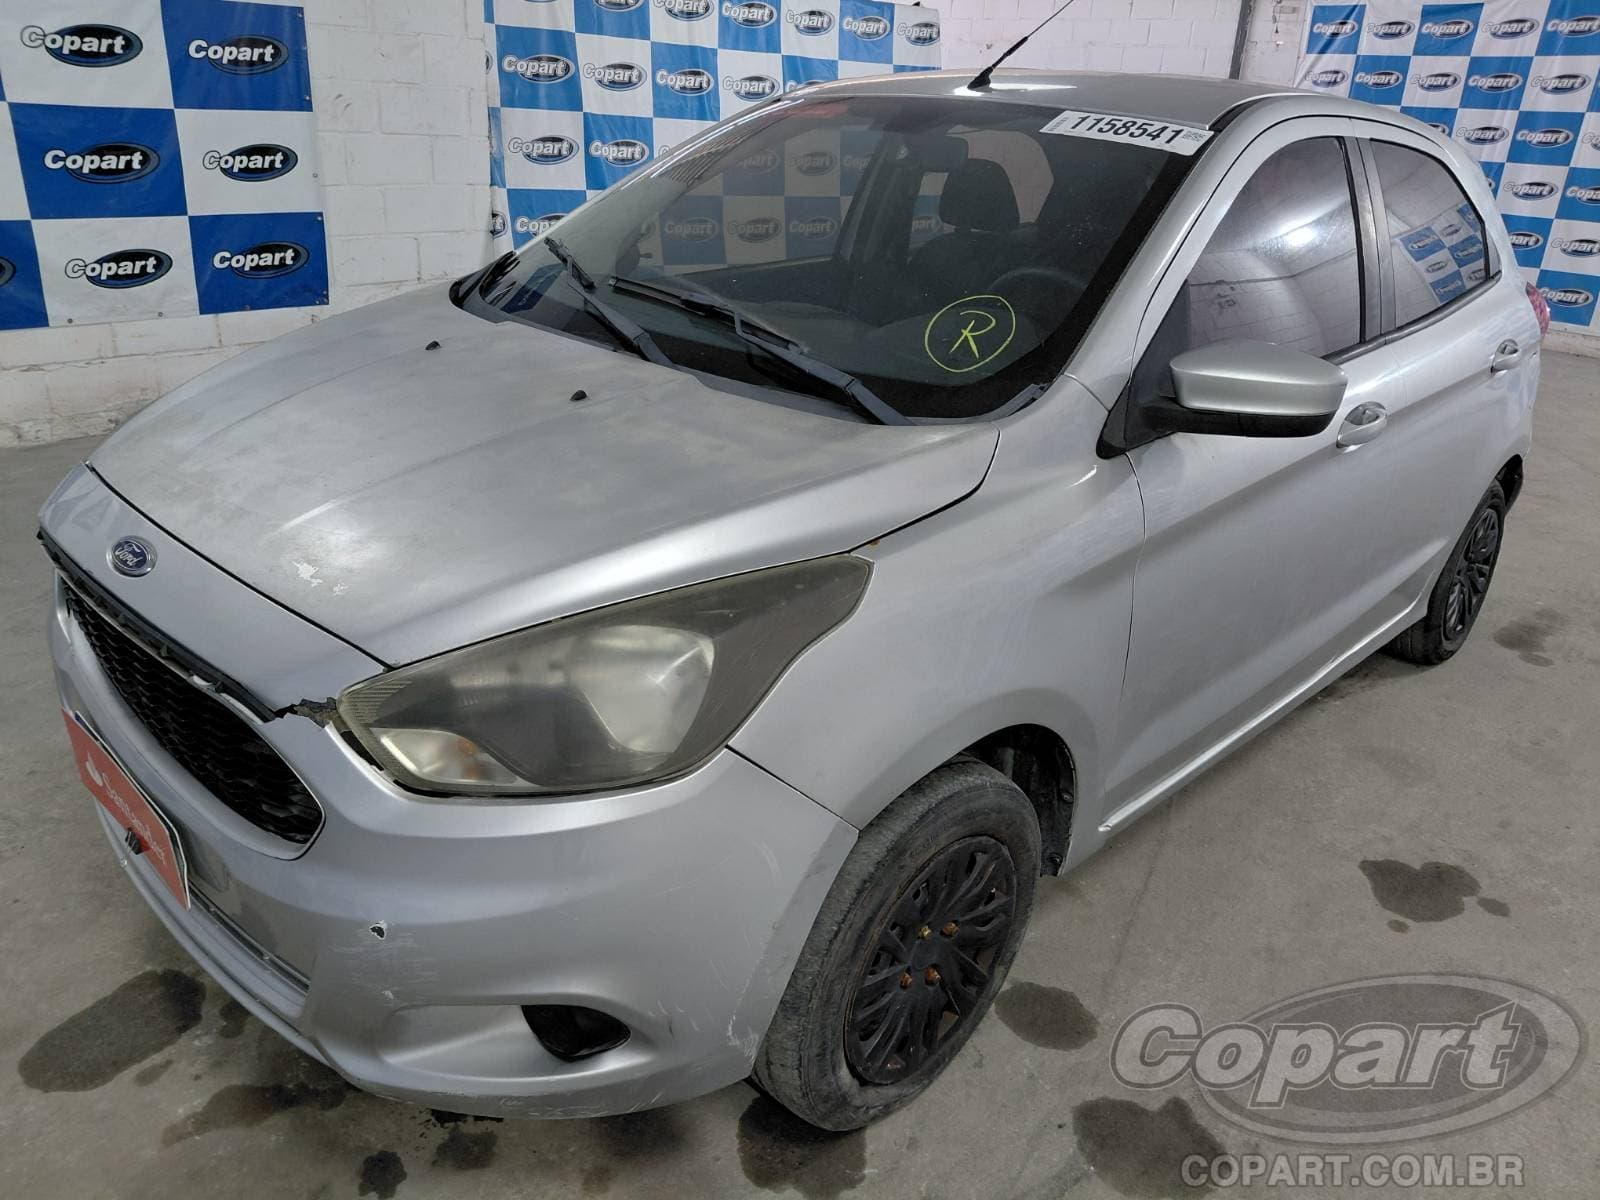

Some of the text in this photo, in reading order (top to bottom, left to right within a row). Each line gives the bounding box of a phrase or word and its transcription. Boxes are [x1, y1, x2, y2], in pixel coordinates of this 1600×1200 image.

[653, 0, 706, 12] Copart
[722, 4, 770, 23] Copart
[786, 10, 828, 28] Copart
[843, 17, 884, 35] Copart
[1546, 18, 1600, 34] Copart
[897, 23, 938, 41] Copart
[1312, 22, 1353, 36] Copart
[1366, 23, 1408, 37] Copart
[1421, 21, 1468, 36] Copart
[1481, 21, 1531, 36] Copart
[21, 25, 125, 54] Copart
[188, 40, 274, 63] Copart
[503, 56, 566, 76] Copart
[583, 63, 639, 82] Copart
[656, 69, 708, 90] Copart
[723, 76, 772, 94] Copart
[1305, 71, 1344, 85] Copart
[1354, 71, 1397, 85] Copart
[1410, 74, 1453, 89] Copart
[1468, 75, 1515, 89] Copart
[1531, 75, 1582, 91] Copart
[1070, 115, 1184, 144] 1158541
[1456, 126, 1503, 141] Copart
[1515, 130, 1567, 144] Copart
[508, 137, 574, 157] Copart
[590, 141, 642, 160] Copart
[44, 149, 144, 173] Copart
[203, 150, 284, 172] Copart
[785, 154, 830, 169] Copart
[1503, 181, 1550, 196] Copart
[665, 221, 713, 238] Copart
[728, 221, 776, 238] Copart
[789, 219, 832, 235] Copart
[1551, 237, 1600, 253] Copart
[65, 256, 157, 280] Copart
[213, 248, 294, 271] Copart
[1540, 287, 1587, 303] Copart
[949, 310, 996, 359] R
[115, 543, 143, 567] Ford
